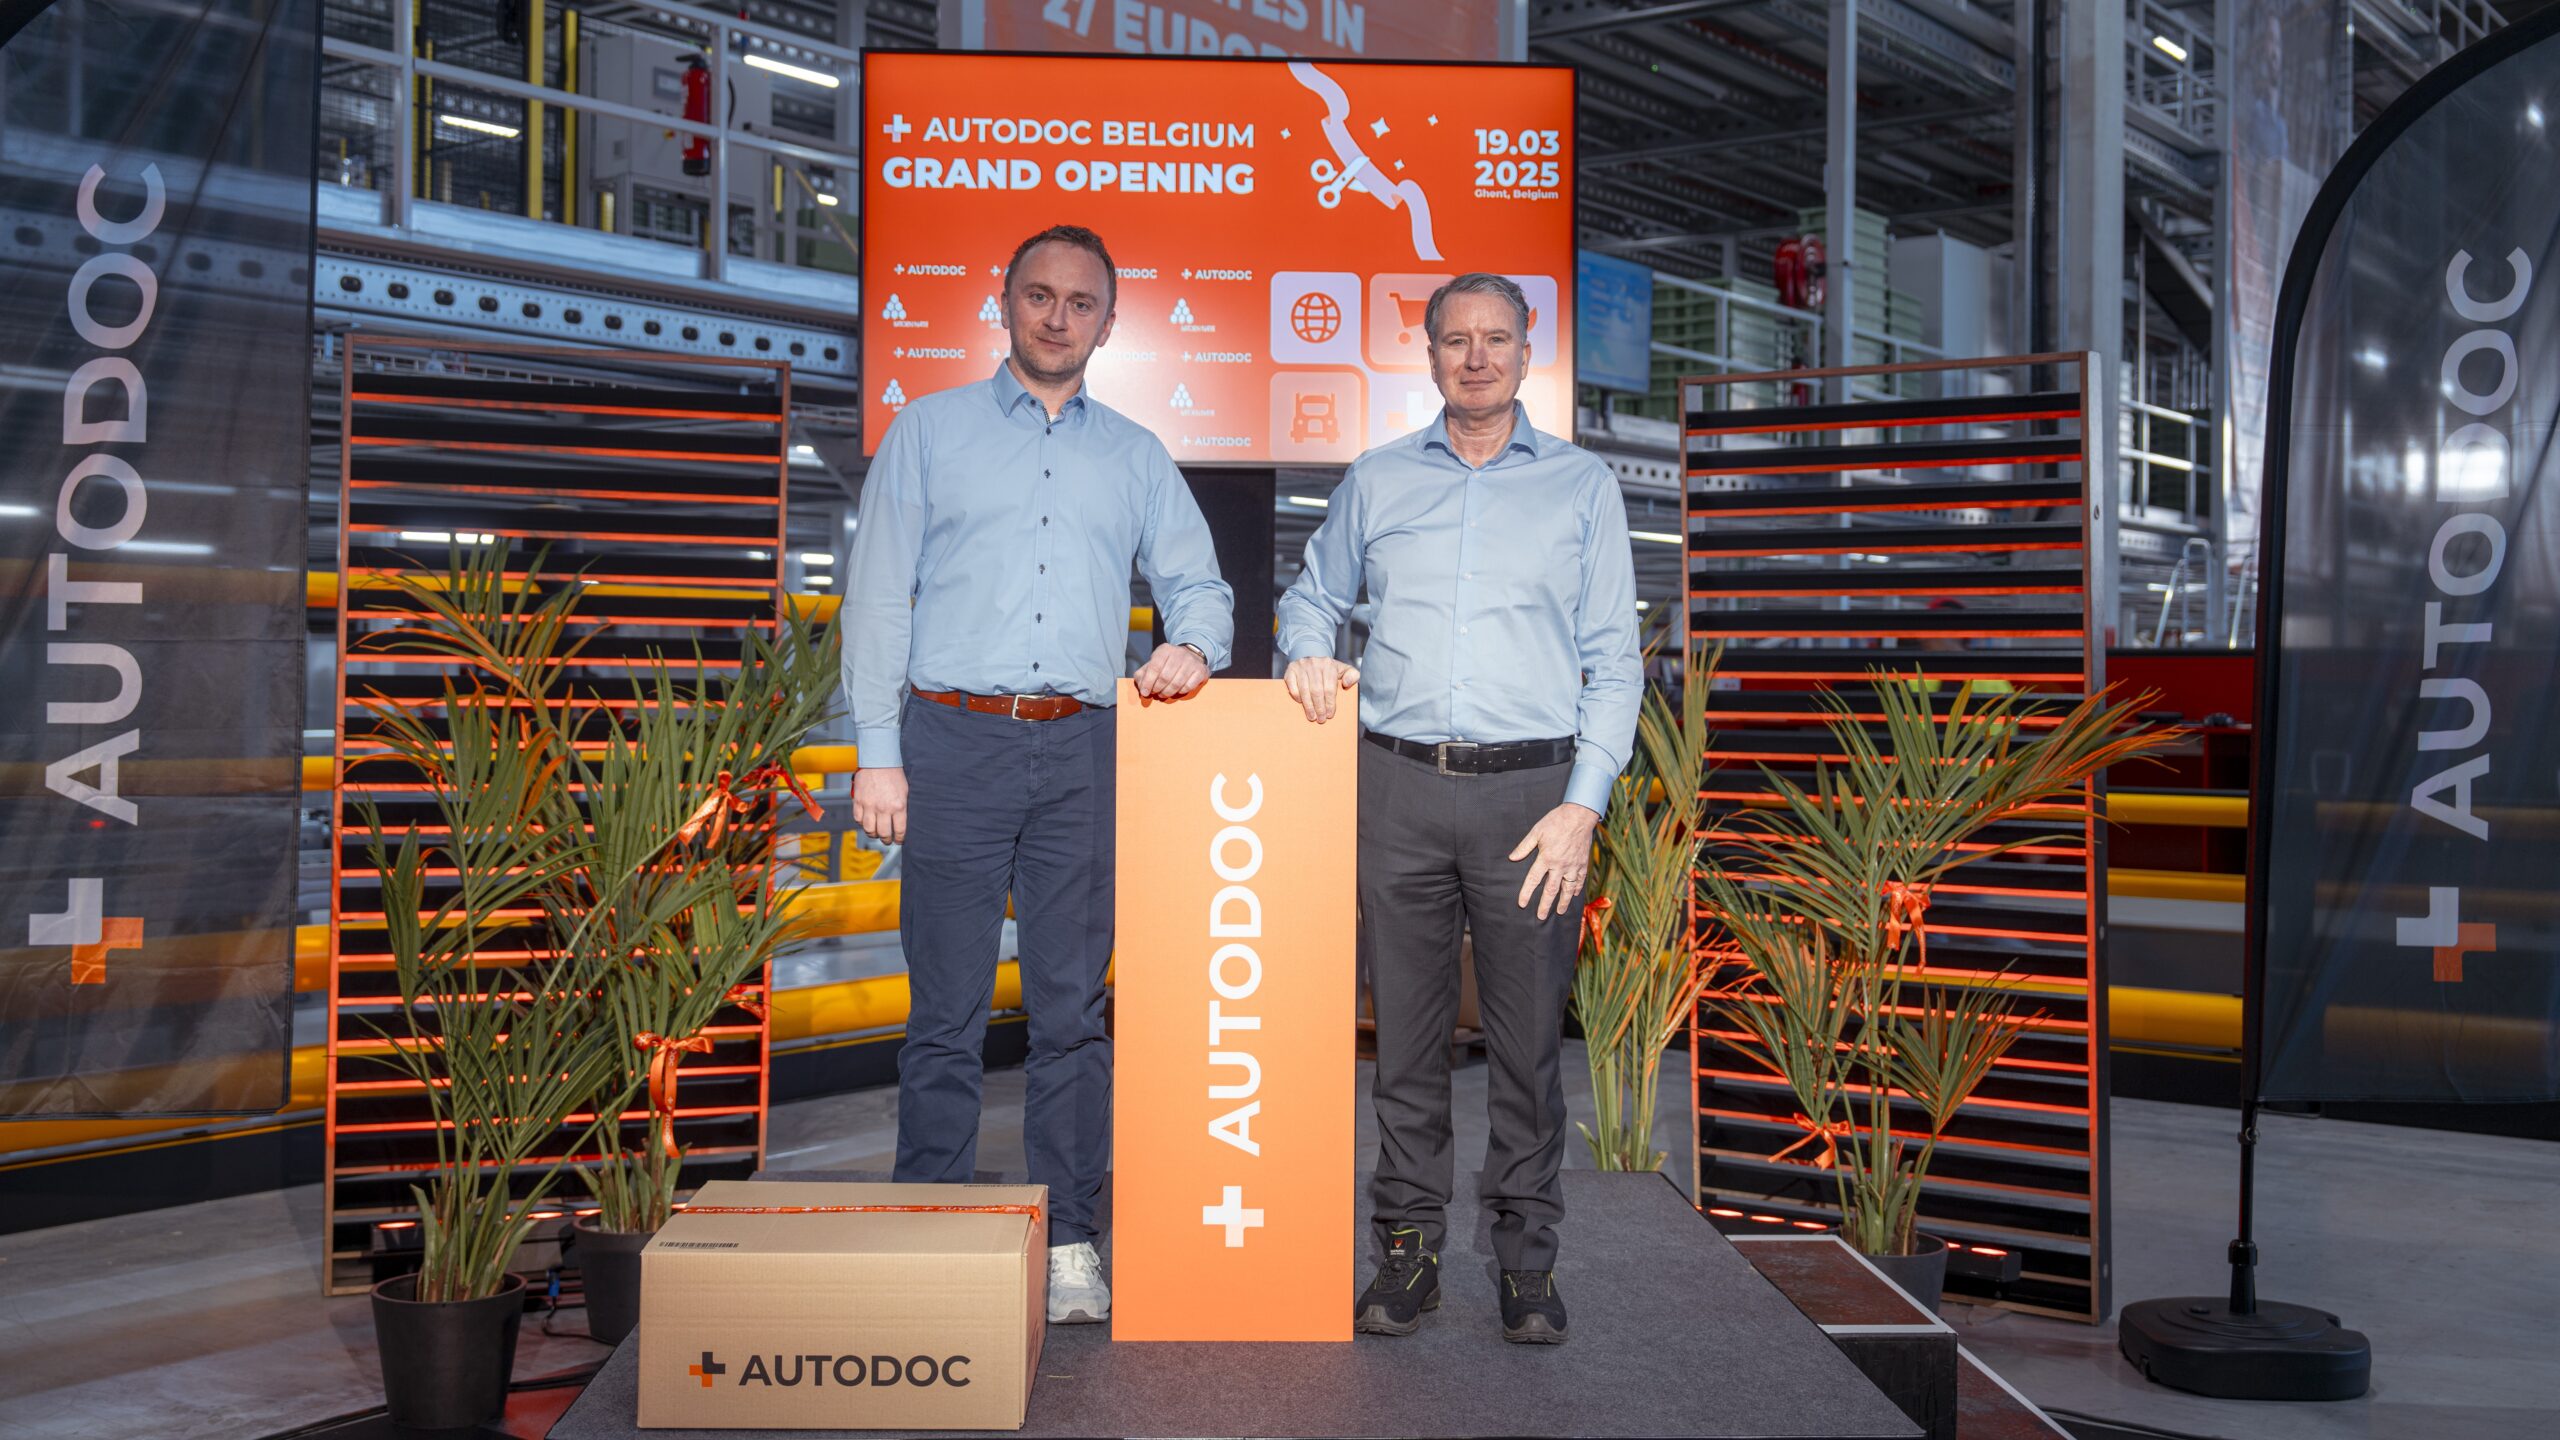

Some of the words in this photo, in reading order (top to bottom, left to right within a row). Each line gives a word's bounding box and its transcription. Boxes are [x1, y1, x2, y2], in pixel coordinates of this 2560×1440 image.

[1322, 0, 1365, 54] IN
[923, 117, 1092, 145] AUTODOC
[1103, 121, 1254, 148] BELGIUM
[1474, 129, 1560, 156] 19.03
[882, 157, 1041, 190] GRAND
[1055, 160, 1255, 195] OPENING
[1474, 160, 1560, 188] 2025
[1474, 188, 1511, 200] Ghent,
[1513, 188, 1559, 201] Belgium
[907, 265, 967, 276] AUTODOC
[1115, 268, 1158, 279] TODOC
[1195, 269, 1252, 280] AUTODOC
[906, 347, 967, 359] AUTODOC
[1194, 352, 1252, 363] AUTODOC
[1194, 436, 1251, 447] AUTODOC
[45, 162, 166, 827] AUTODOC
[2410, 246, 2533, 841] AUTODOC
[1208, 772, 1264, 1157] AUTODOC
[738, 1355, 971, 1387] AUTODOC
